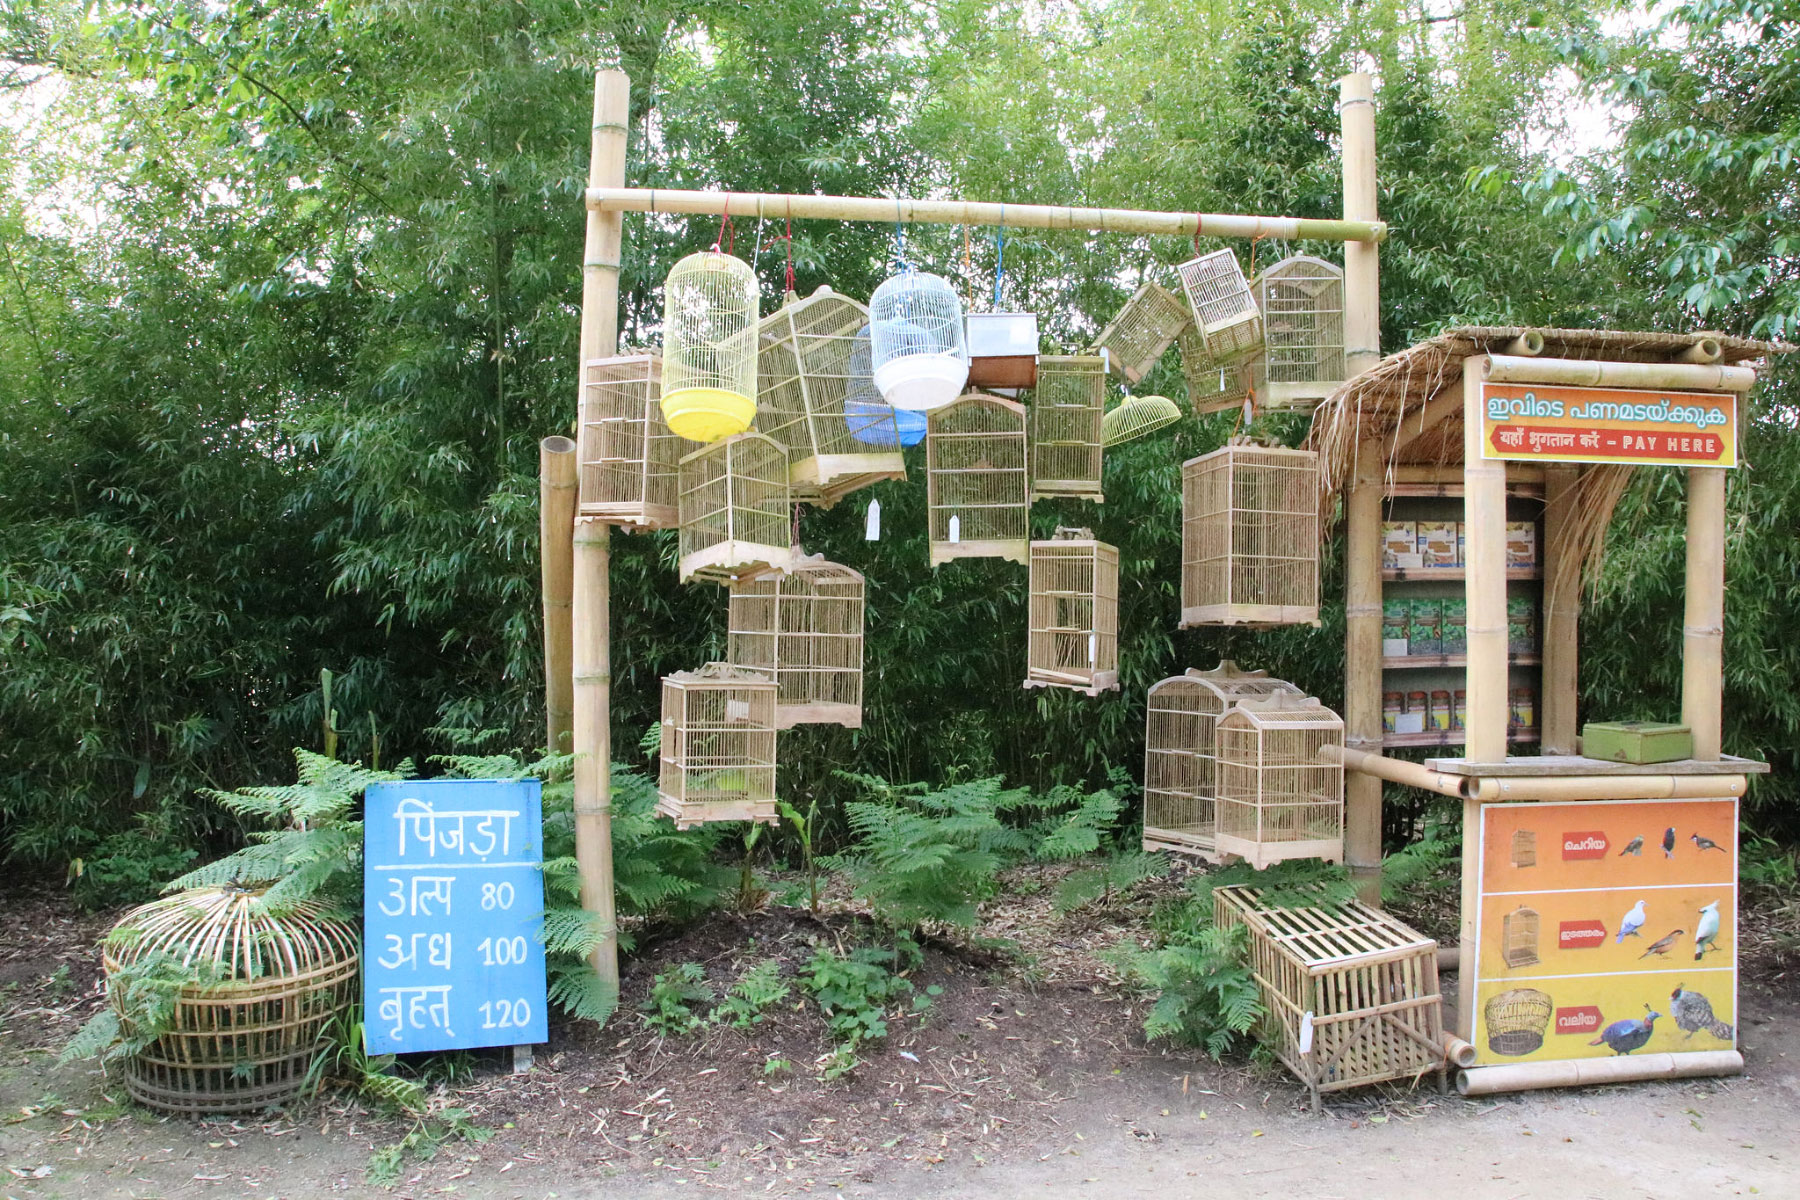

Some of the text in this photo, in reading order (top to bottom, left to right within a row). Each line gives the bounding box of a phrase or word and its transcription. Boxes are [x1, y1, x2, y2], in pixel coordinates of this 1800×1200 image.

[1487, 391, 1728, 429] ഇവിടെ പണമടയ്ക്കുക
[1499, 427, 1524, 448] यहाँ
[1529, 431, 1576, 453] भुगतान
[1579, 431, 1600, 449] करें
[1622, 435, 1658, 451] PAY
[1667, 438, 1716, 453] HERE
[393, 798, 520, 862] पिंजड़ा
[1564, 836, 1606, 851] ചെറിയ
[378, 876, 515, 917] अल्प 80
[477, 936, 528, 966] 100
[379, 985, 531, 1042] बृहत् 120
[1558, 1011, 1597, 1027] വലിയ
